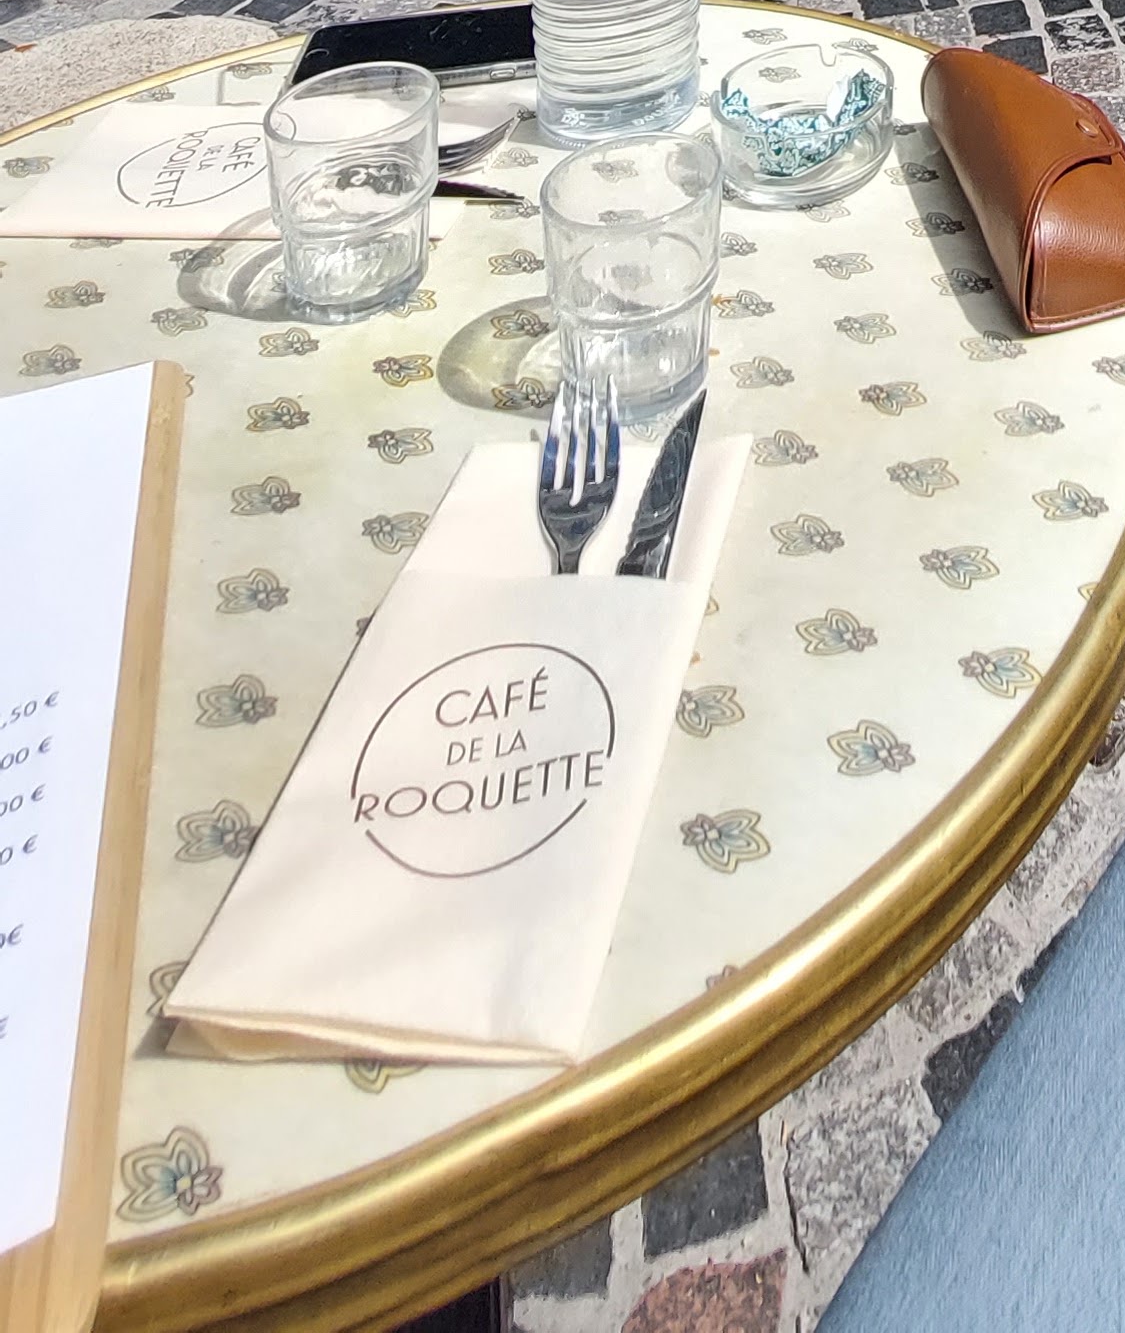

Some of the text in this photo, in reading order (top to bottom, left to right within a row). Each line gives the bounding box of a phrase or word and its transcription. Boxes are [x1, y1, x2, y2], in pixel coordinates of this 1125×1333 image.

[144, 129, 209, 209] ROQUETTE
[196, 143, 225, 172] DE LA
[221, 136, 261, 173] CAFÉ
[45, 691, 60, 709] €
[435, 665, 549, 728] CAFÉ
[38, 735, 53, 754] €
[446, 728, 527, 766] DE LA
[31, 784, 46, 802] €
[354, 749, 605, 823] ROQUETTE
[23, 834, 39, 855] €
